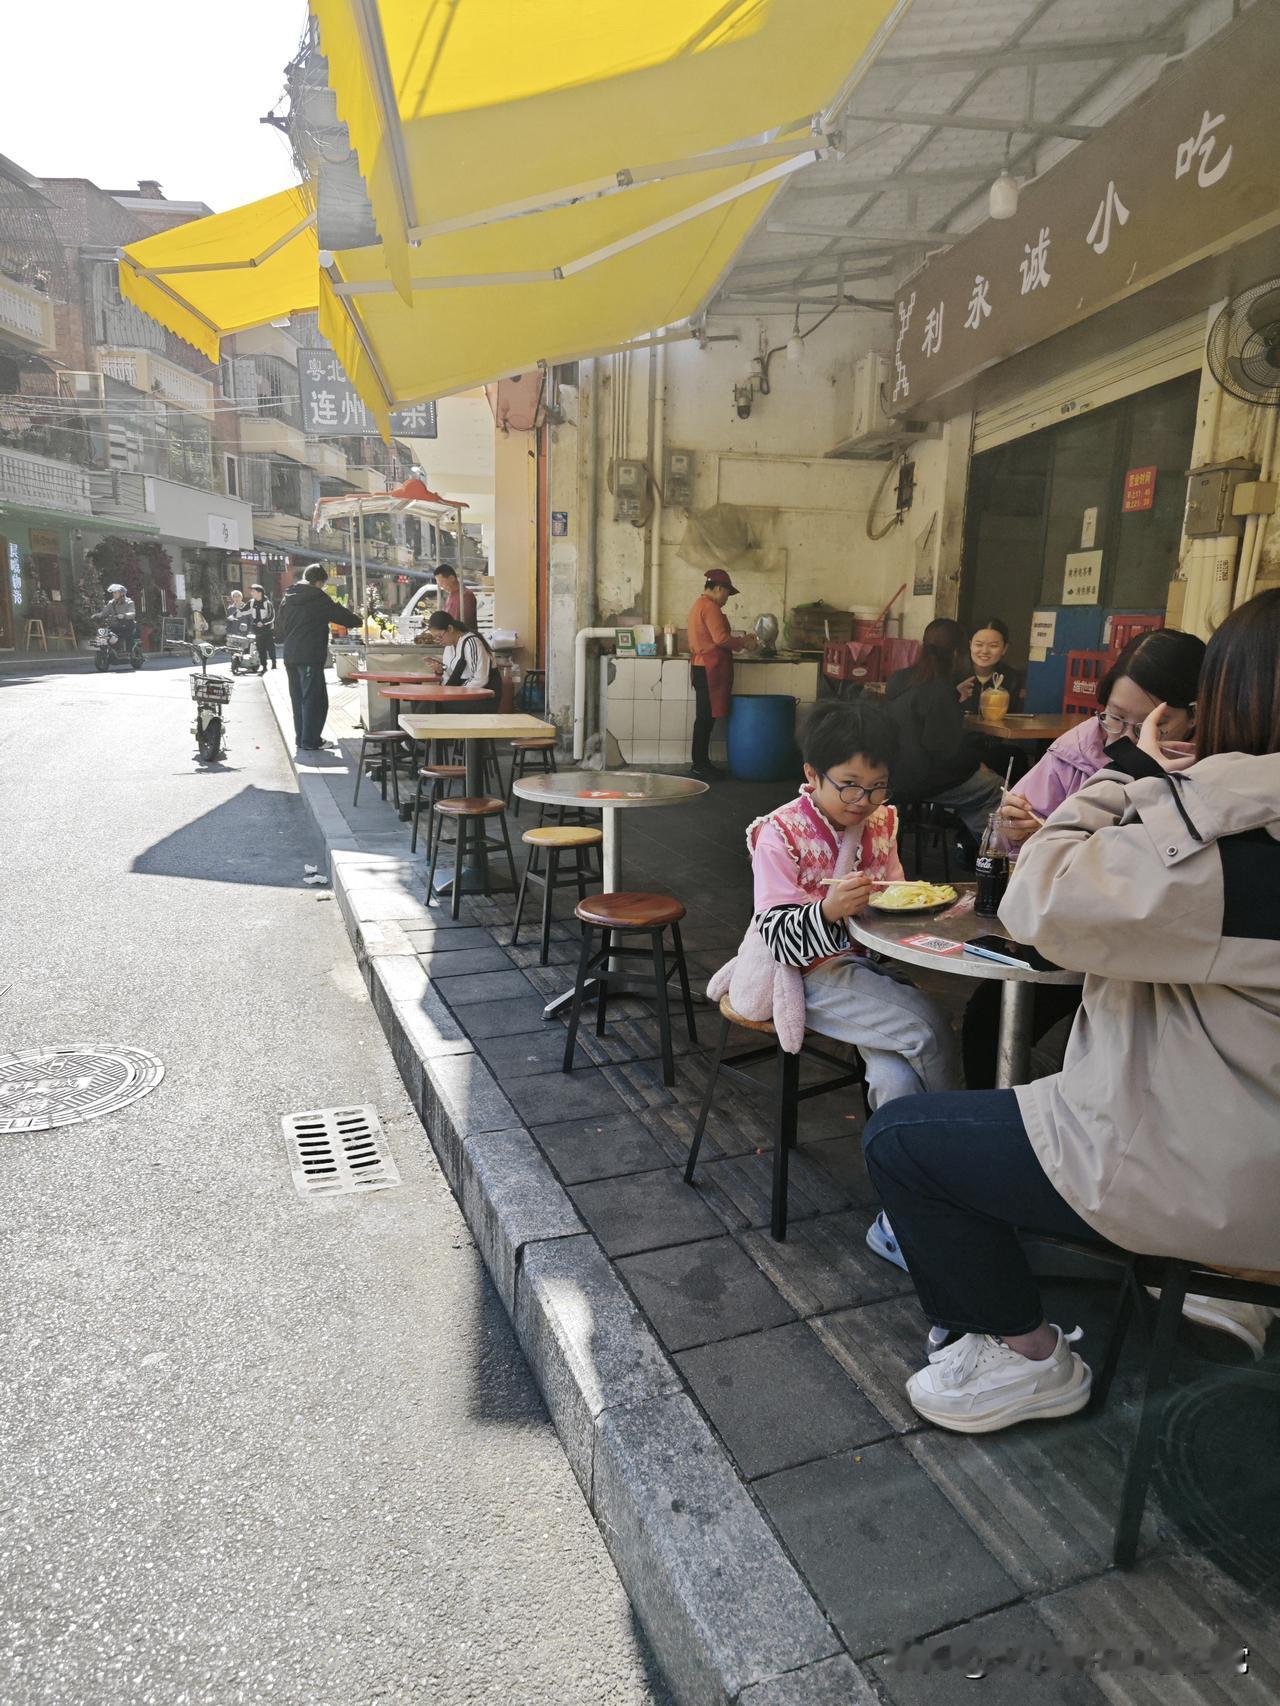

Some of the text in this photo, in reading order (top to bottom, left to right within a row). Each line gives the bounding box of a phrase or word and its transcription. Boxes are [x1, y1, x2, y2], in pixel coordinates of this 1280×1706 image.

[921, 110, 1233, 358] 利永诚小吃
